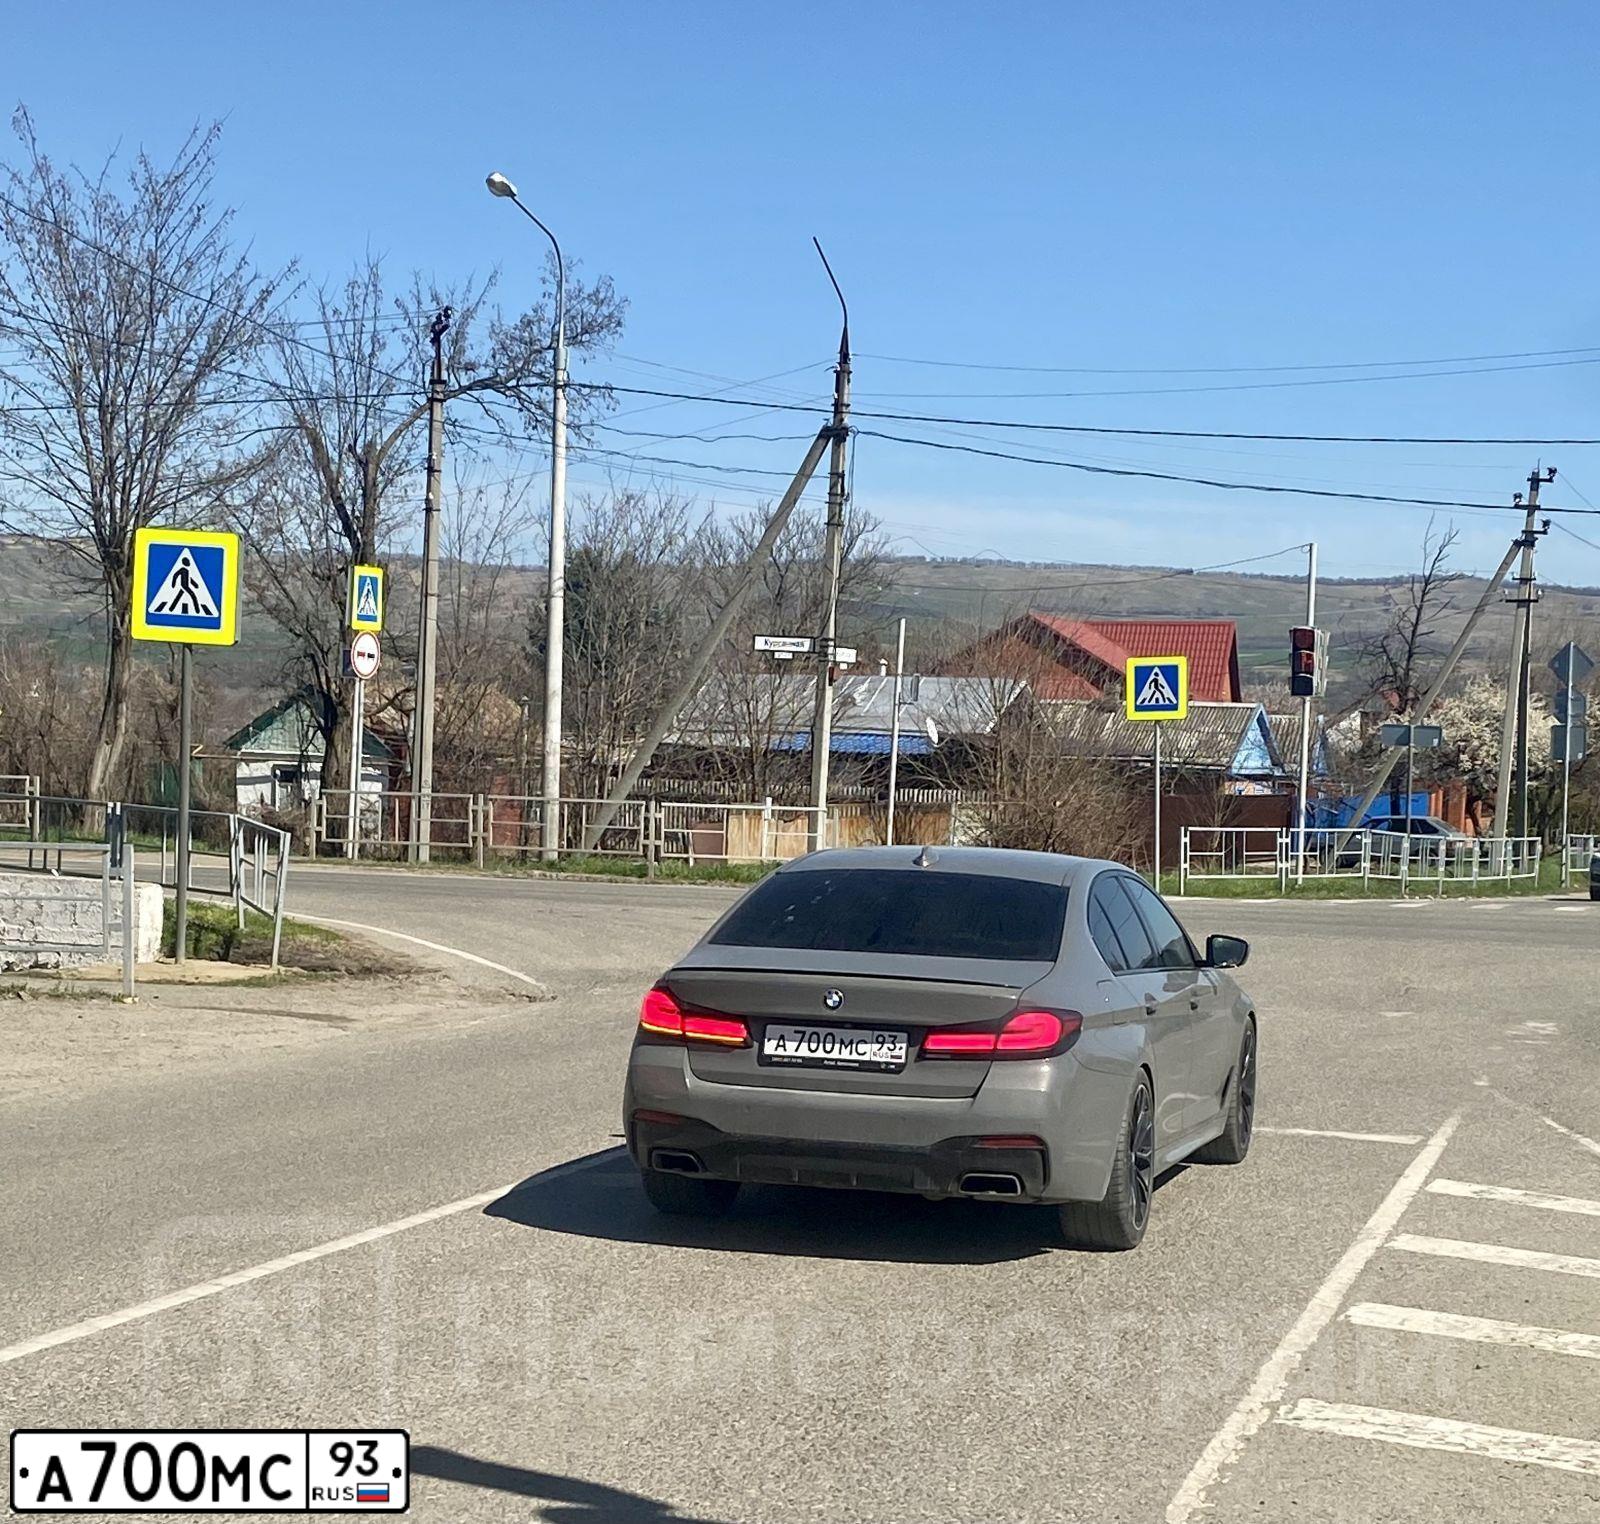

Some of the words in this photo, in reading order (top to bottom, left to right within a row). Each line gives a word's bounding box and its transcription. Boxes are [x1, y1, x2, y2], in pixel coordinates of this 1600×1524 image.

[774, 1030, 868, 1056] А700МС
[875, 1034, 898, 1052] 93
[873, 1051, 890, 1059] RUS
